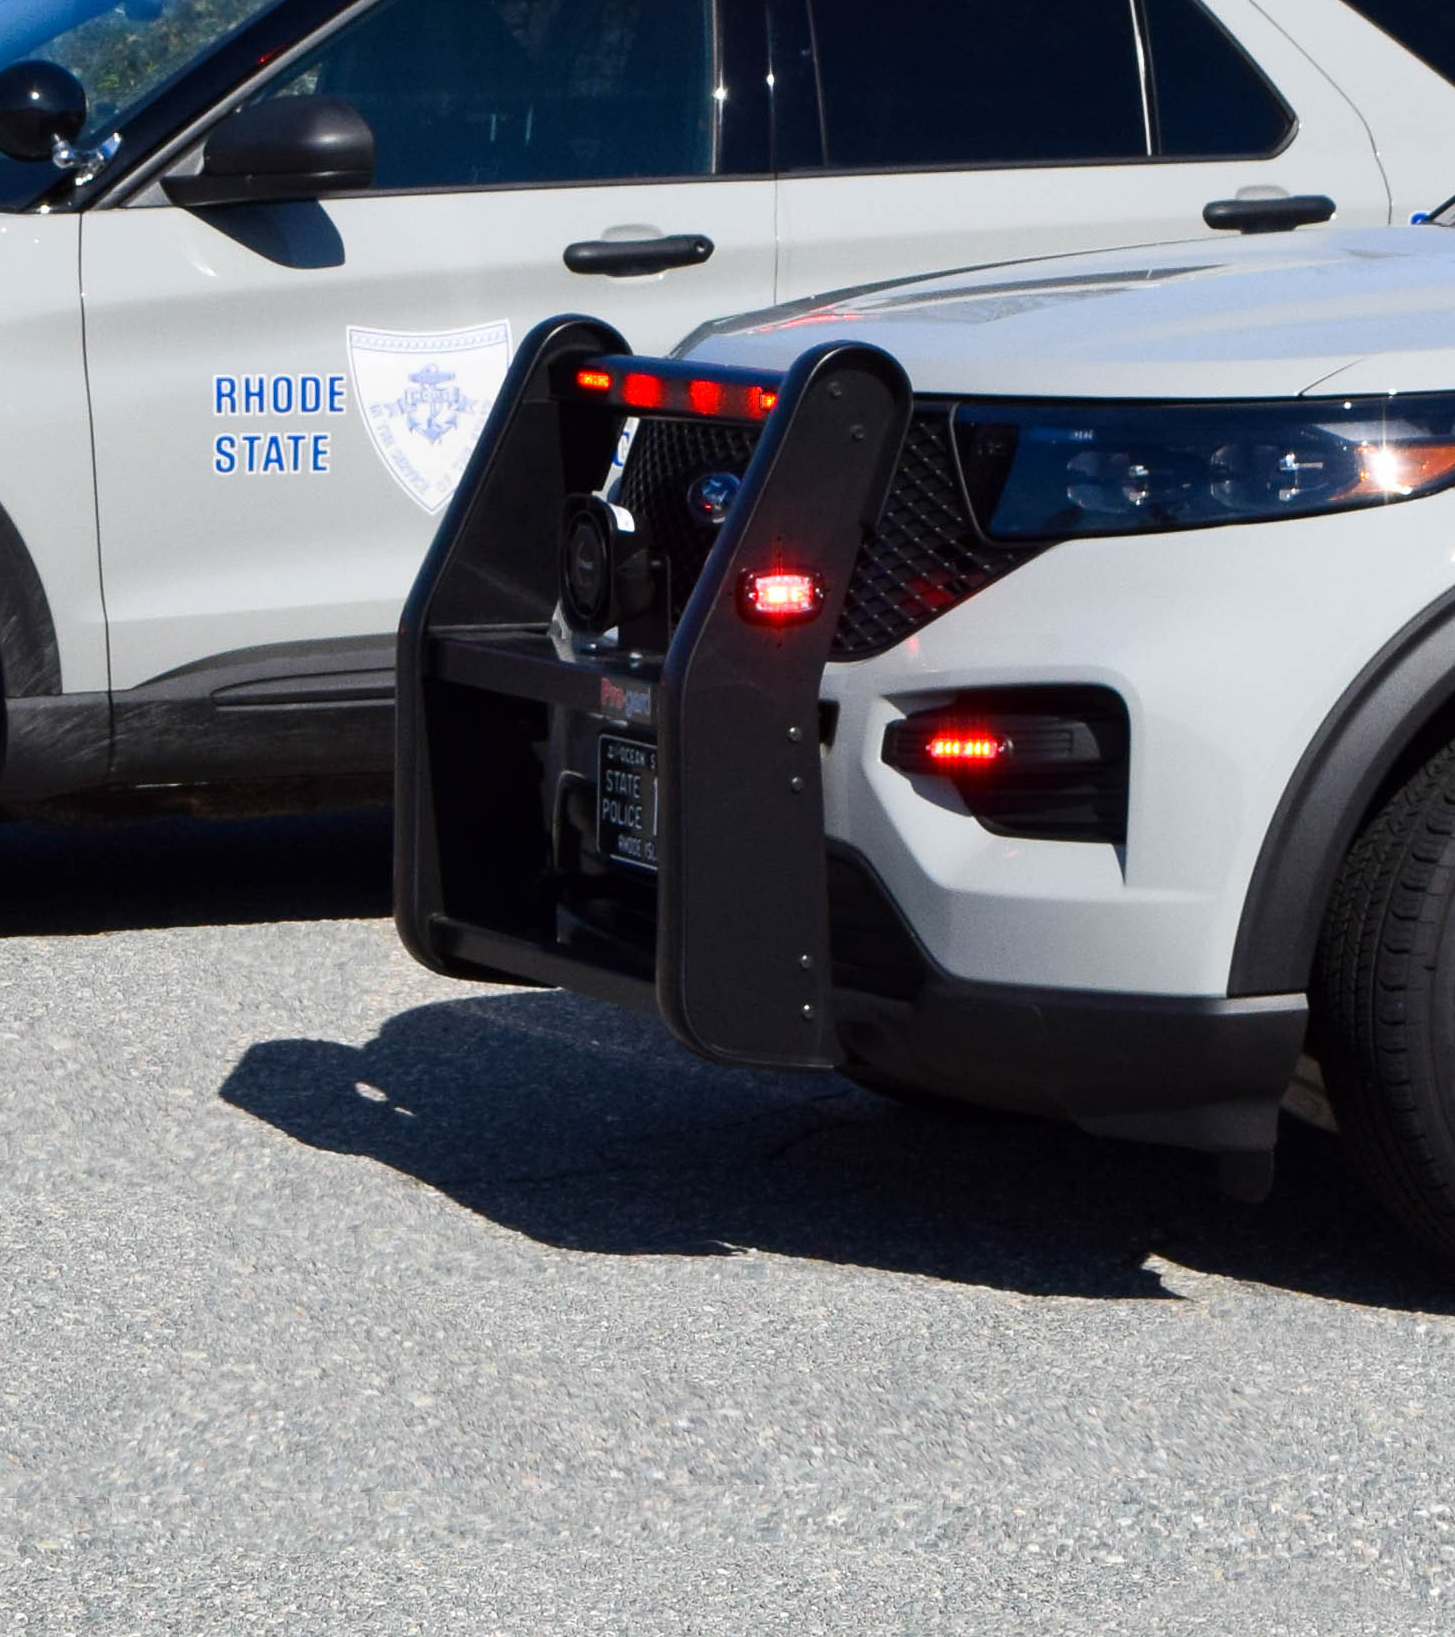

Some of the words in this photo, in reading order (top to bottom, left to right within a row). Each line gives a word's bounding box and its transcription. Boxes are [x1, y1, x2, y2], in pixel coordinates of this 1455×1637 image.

[215, 375, 345, 415] RHODE
[215, 435, 329, 474] STATE
[605, 769, 642, 799] STATE
[602, 798, 643, 831] POLICE
